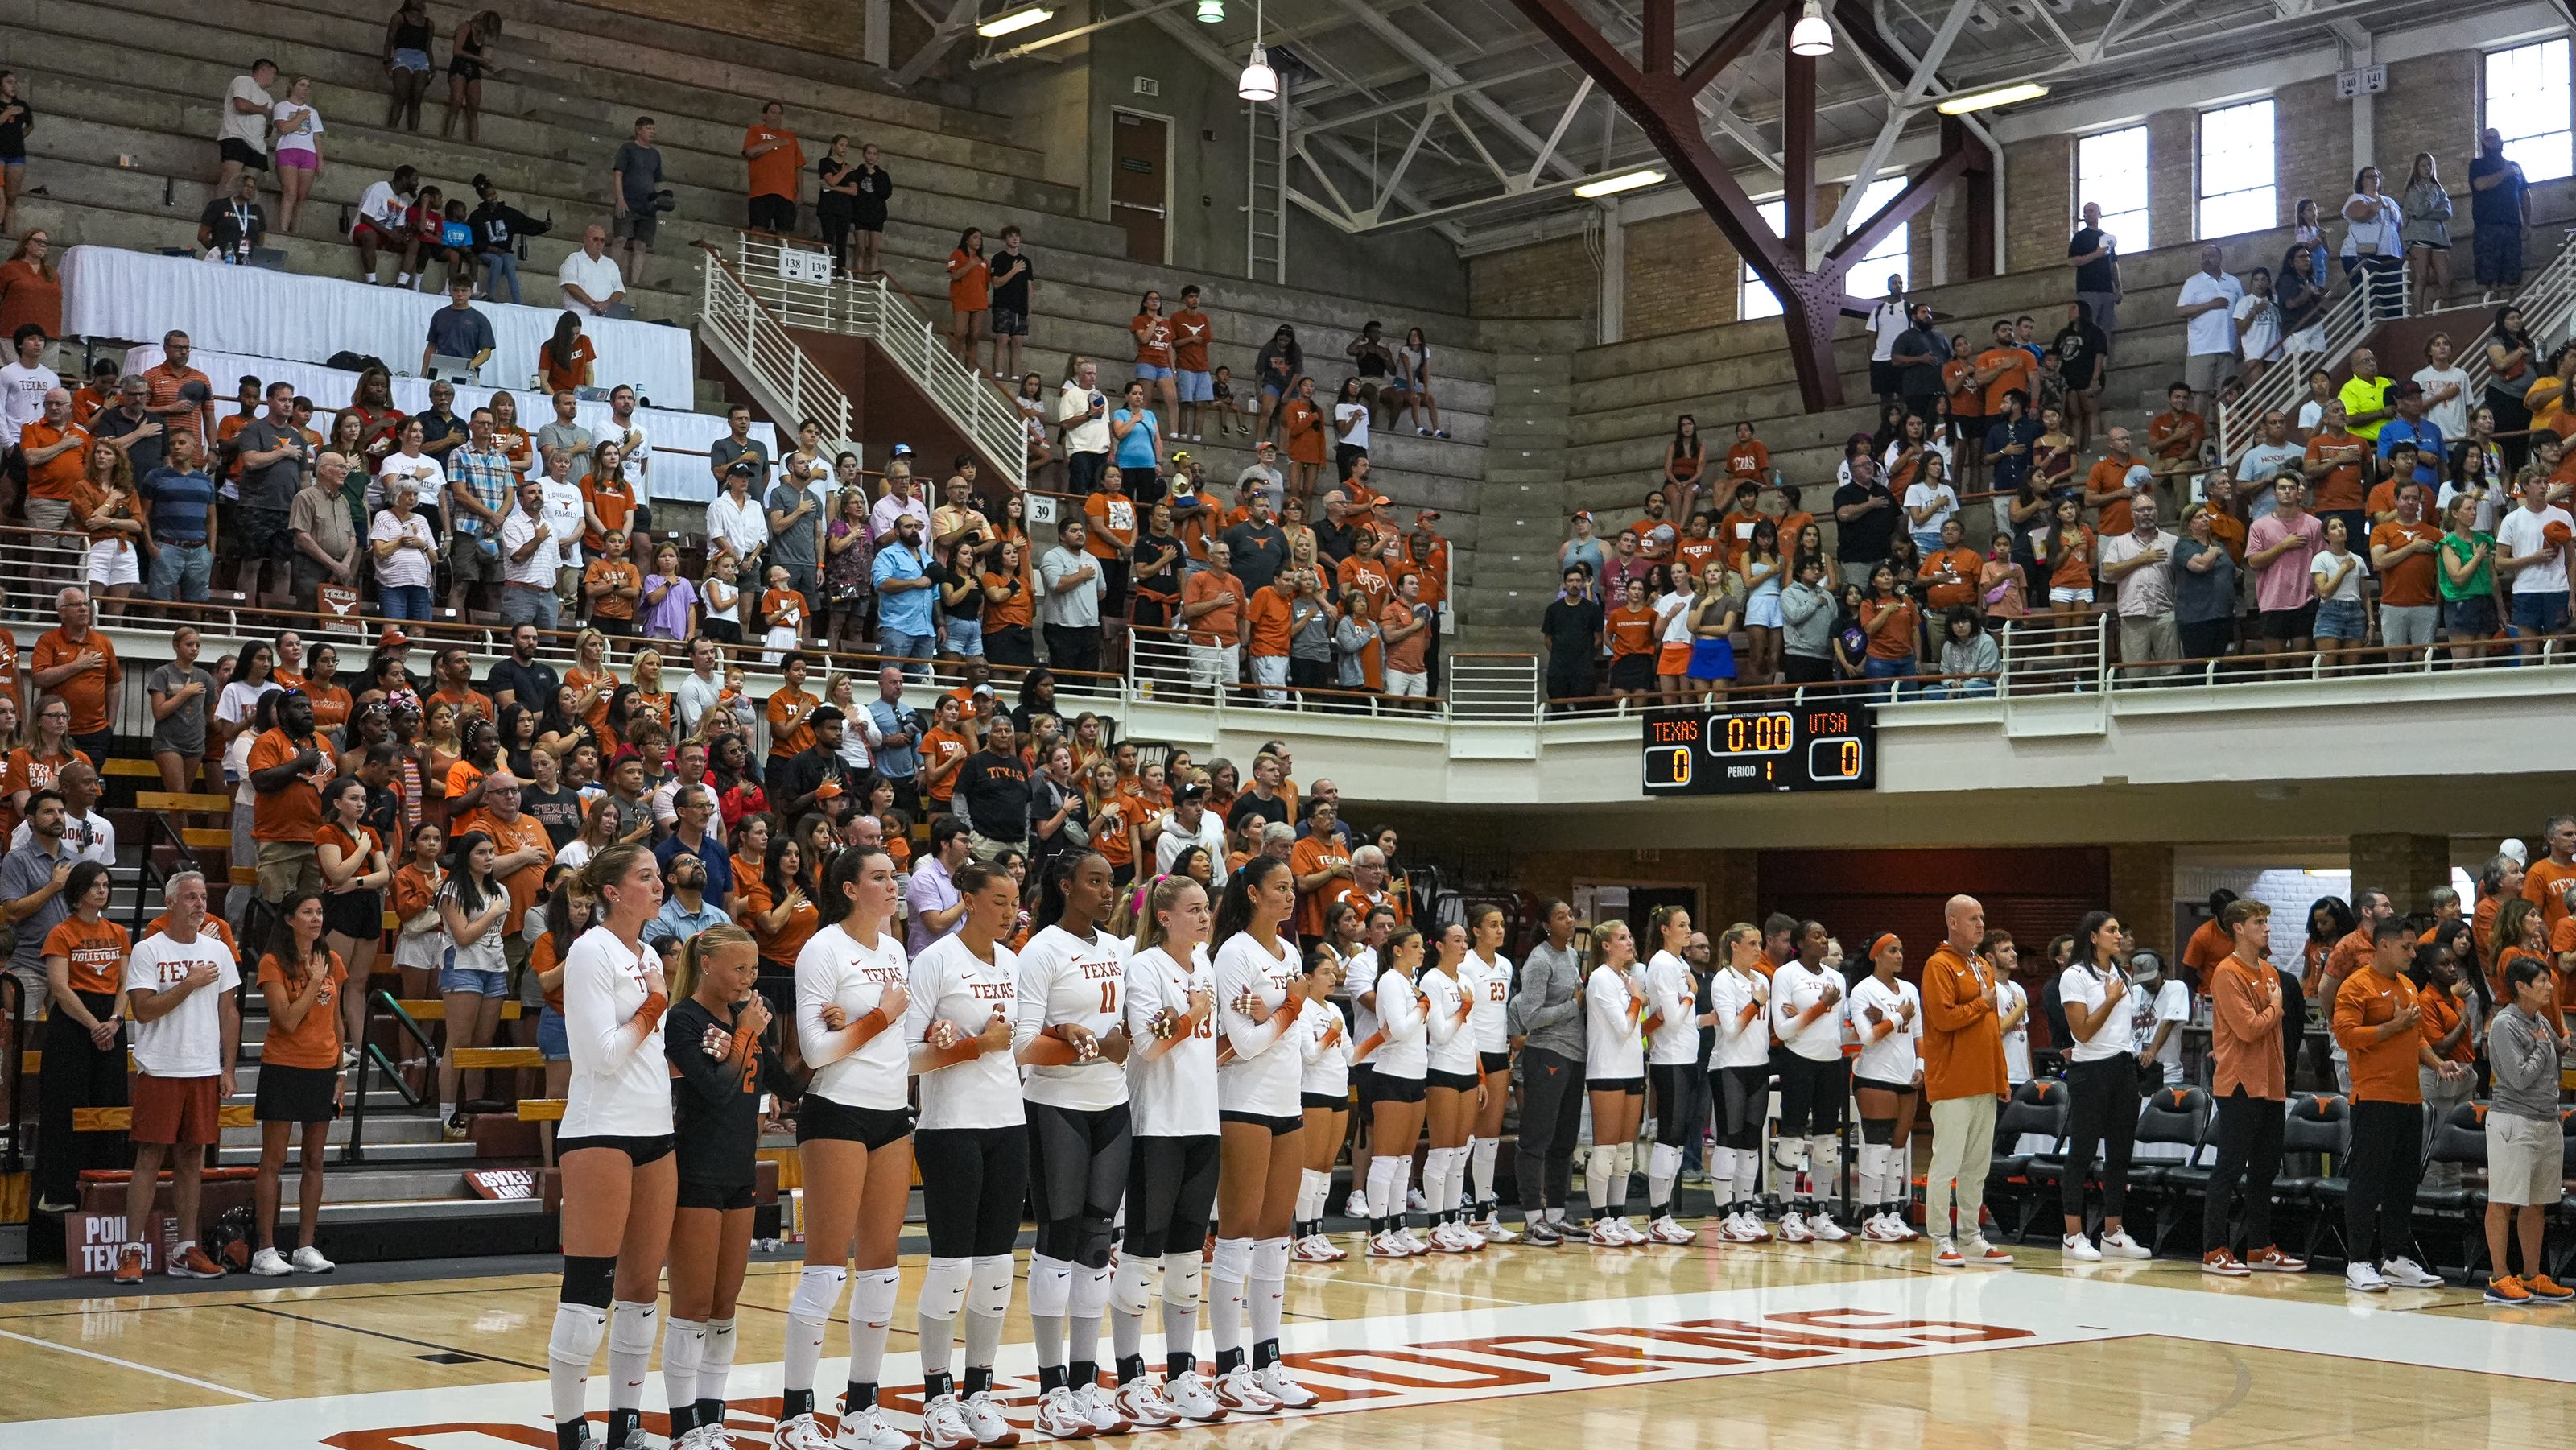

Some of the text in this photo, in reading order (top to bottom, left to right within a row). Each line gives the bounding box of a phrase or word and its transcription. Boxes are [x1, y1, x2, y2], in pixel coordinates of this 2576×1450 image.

[2342, 77, 2357, 89] 140
[2367, 72, 2380, 84] 141
[786, 258, 802, 270] 138
[811, 262, 827, 273] 139
[19, 380, 48, 391] TEXAS
[555, 509, 578, 519] FAMILY
[1034, 505, 1051, 520] 39
[1682, 545, 1713, 556] TEXAS
[324, 588, 357, 601] TEXAS
[1809, 713, 1847, 733] UTSA
[1653, 721, 1698, 742] TEXAS
[1728, 715, 1790, 752] 0:00
[1841, 741, 1858, 775] 0
[29, 762, 50, 773] 2022
[1674, 749, 1688, 783] 0
[1728, 761, 1772, 781] PERIOD 1
[30, 776, 47, 788] CHA
[72, 951, 122, 963] VOLLEYBAL
[862, 967, 903, 983] TEXAS
[1080, 961, 1122, 979] TEXAS
[969, 982, 1015, 999] TEXAS
[1100, 980, 1116, 1013] 11
[1490, 982, 1505, 1001] 23
[81, 1242, 152, 1273] TEXS!
